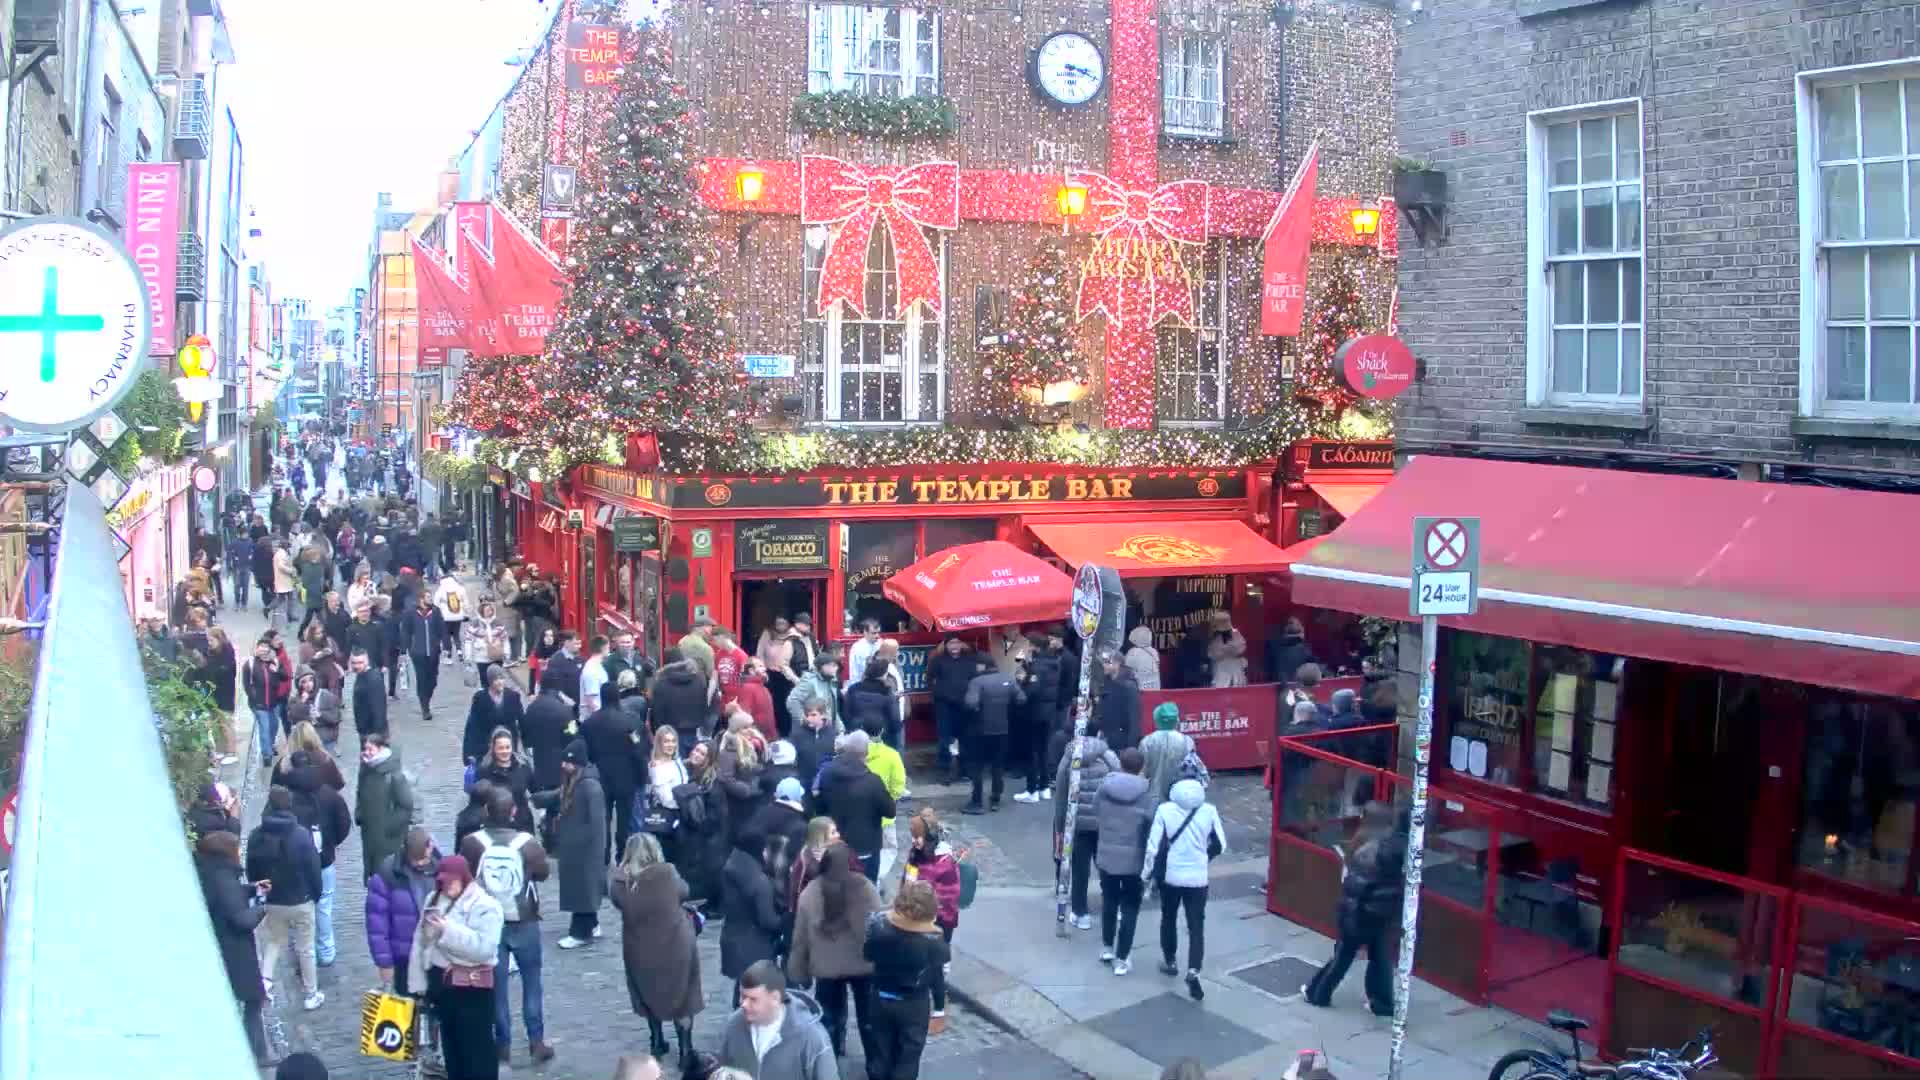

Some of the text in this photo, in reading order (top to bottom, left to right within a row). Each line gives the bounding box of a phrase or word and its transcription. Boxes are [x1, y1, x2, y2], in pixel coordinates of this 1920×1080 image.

[586, 30, 617, 45] THE
[570, 48, 622, 64] TEMPL
[137, 171, 168, 232] NINE
[503, 314, 555, 326] TEMPL
[518, 327, 549, 337] BAR
[89, 303, 136, 401] PHARMACY
[823, 478, 1134, 503] THE TEMPLE BAR
[1422, 584, 1443, 603] 24
[947, 615, 992, 627] GUINNESS
[897, 651, 925, 667] OW
[1201, 711, 1221, 720] THE
[1180, 717, 1249, 732] EMPLE BAR
[377, 1027, 402, 1047] JD
